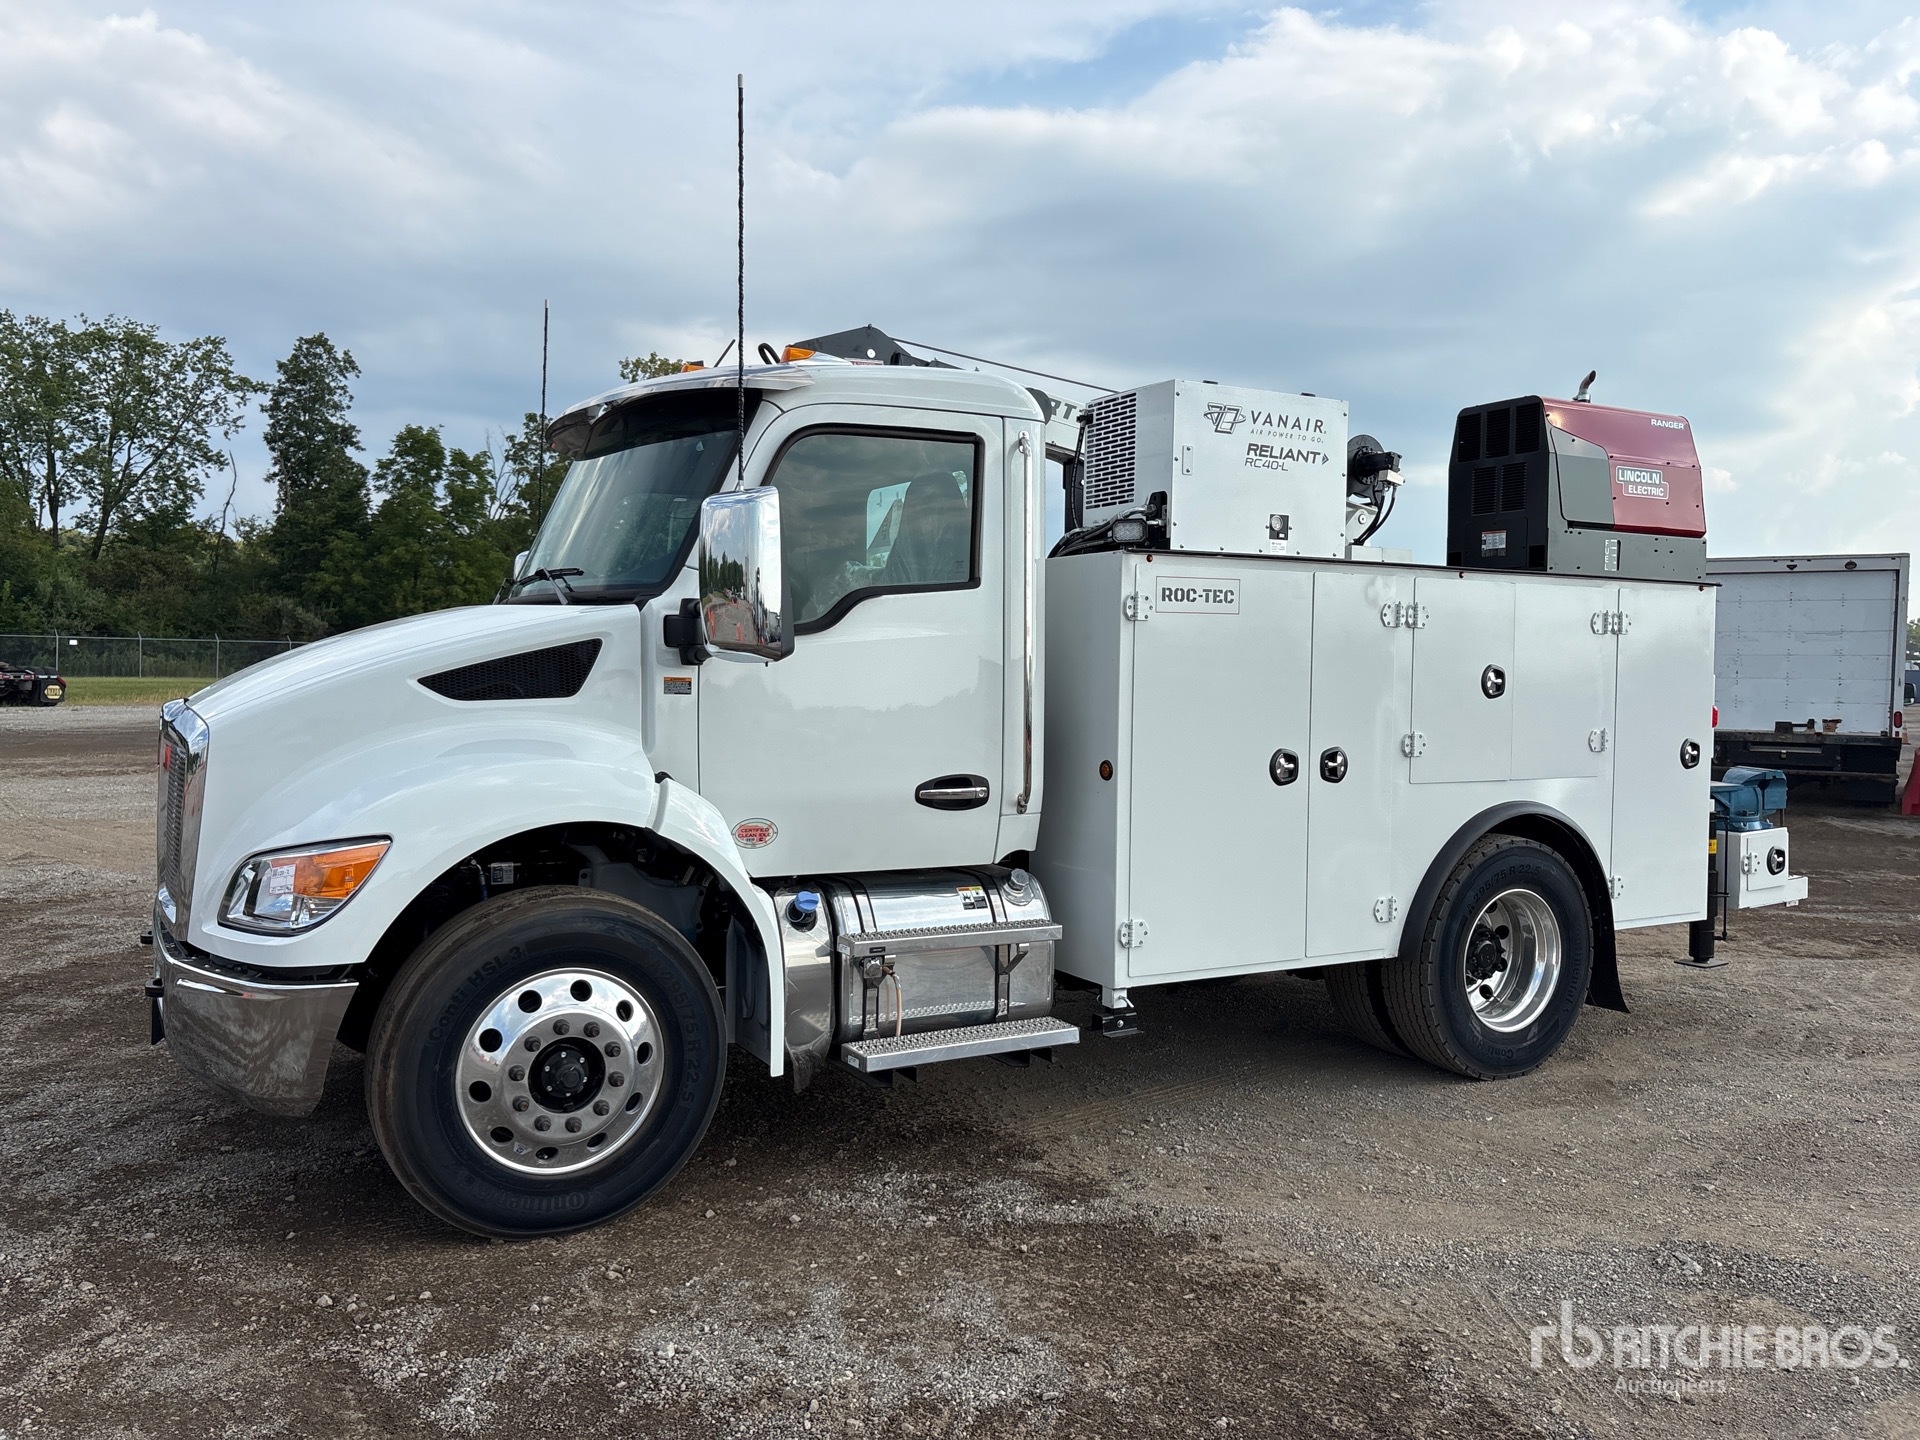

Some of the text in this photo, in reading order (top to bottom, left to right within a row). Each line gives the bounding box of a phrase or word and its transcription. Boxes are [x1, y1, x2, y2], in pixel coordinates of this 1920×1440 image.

[1650, 418, 1685, 430] RANGER
[1267, 431, 1294, 439] POWER
[1246, 443, 1321, 464] RELIANT
[1244, 457, 1289, 471] RC40-L
[1618, 469, 1660, 485] LINCOLN
[1628, 484, 1665, 497] ELECTRIC
[1161, 587, 1235, 604] ROC-TEC
[1474, 869, 1507, 903] 295/75
[1508, 865, 1516, 876] R
[1518, 864, 1541, 876] 22.5
[429, 945, 522, 1041] Conti HSL 3
[661, 971, 700, 1034] 295/75
[687, 1038, 702, 1053] R
[681, 1058, 702, 1104] 22.5
